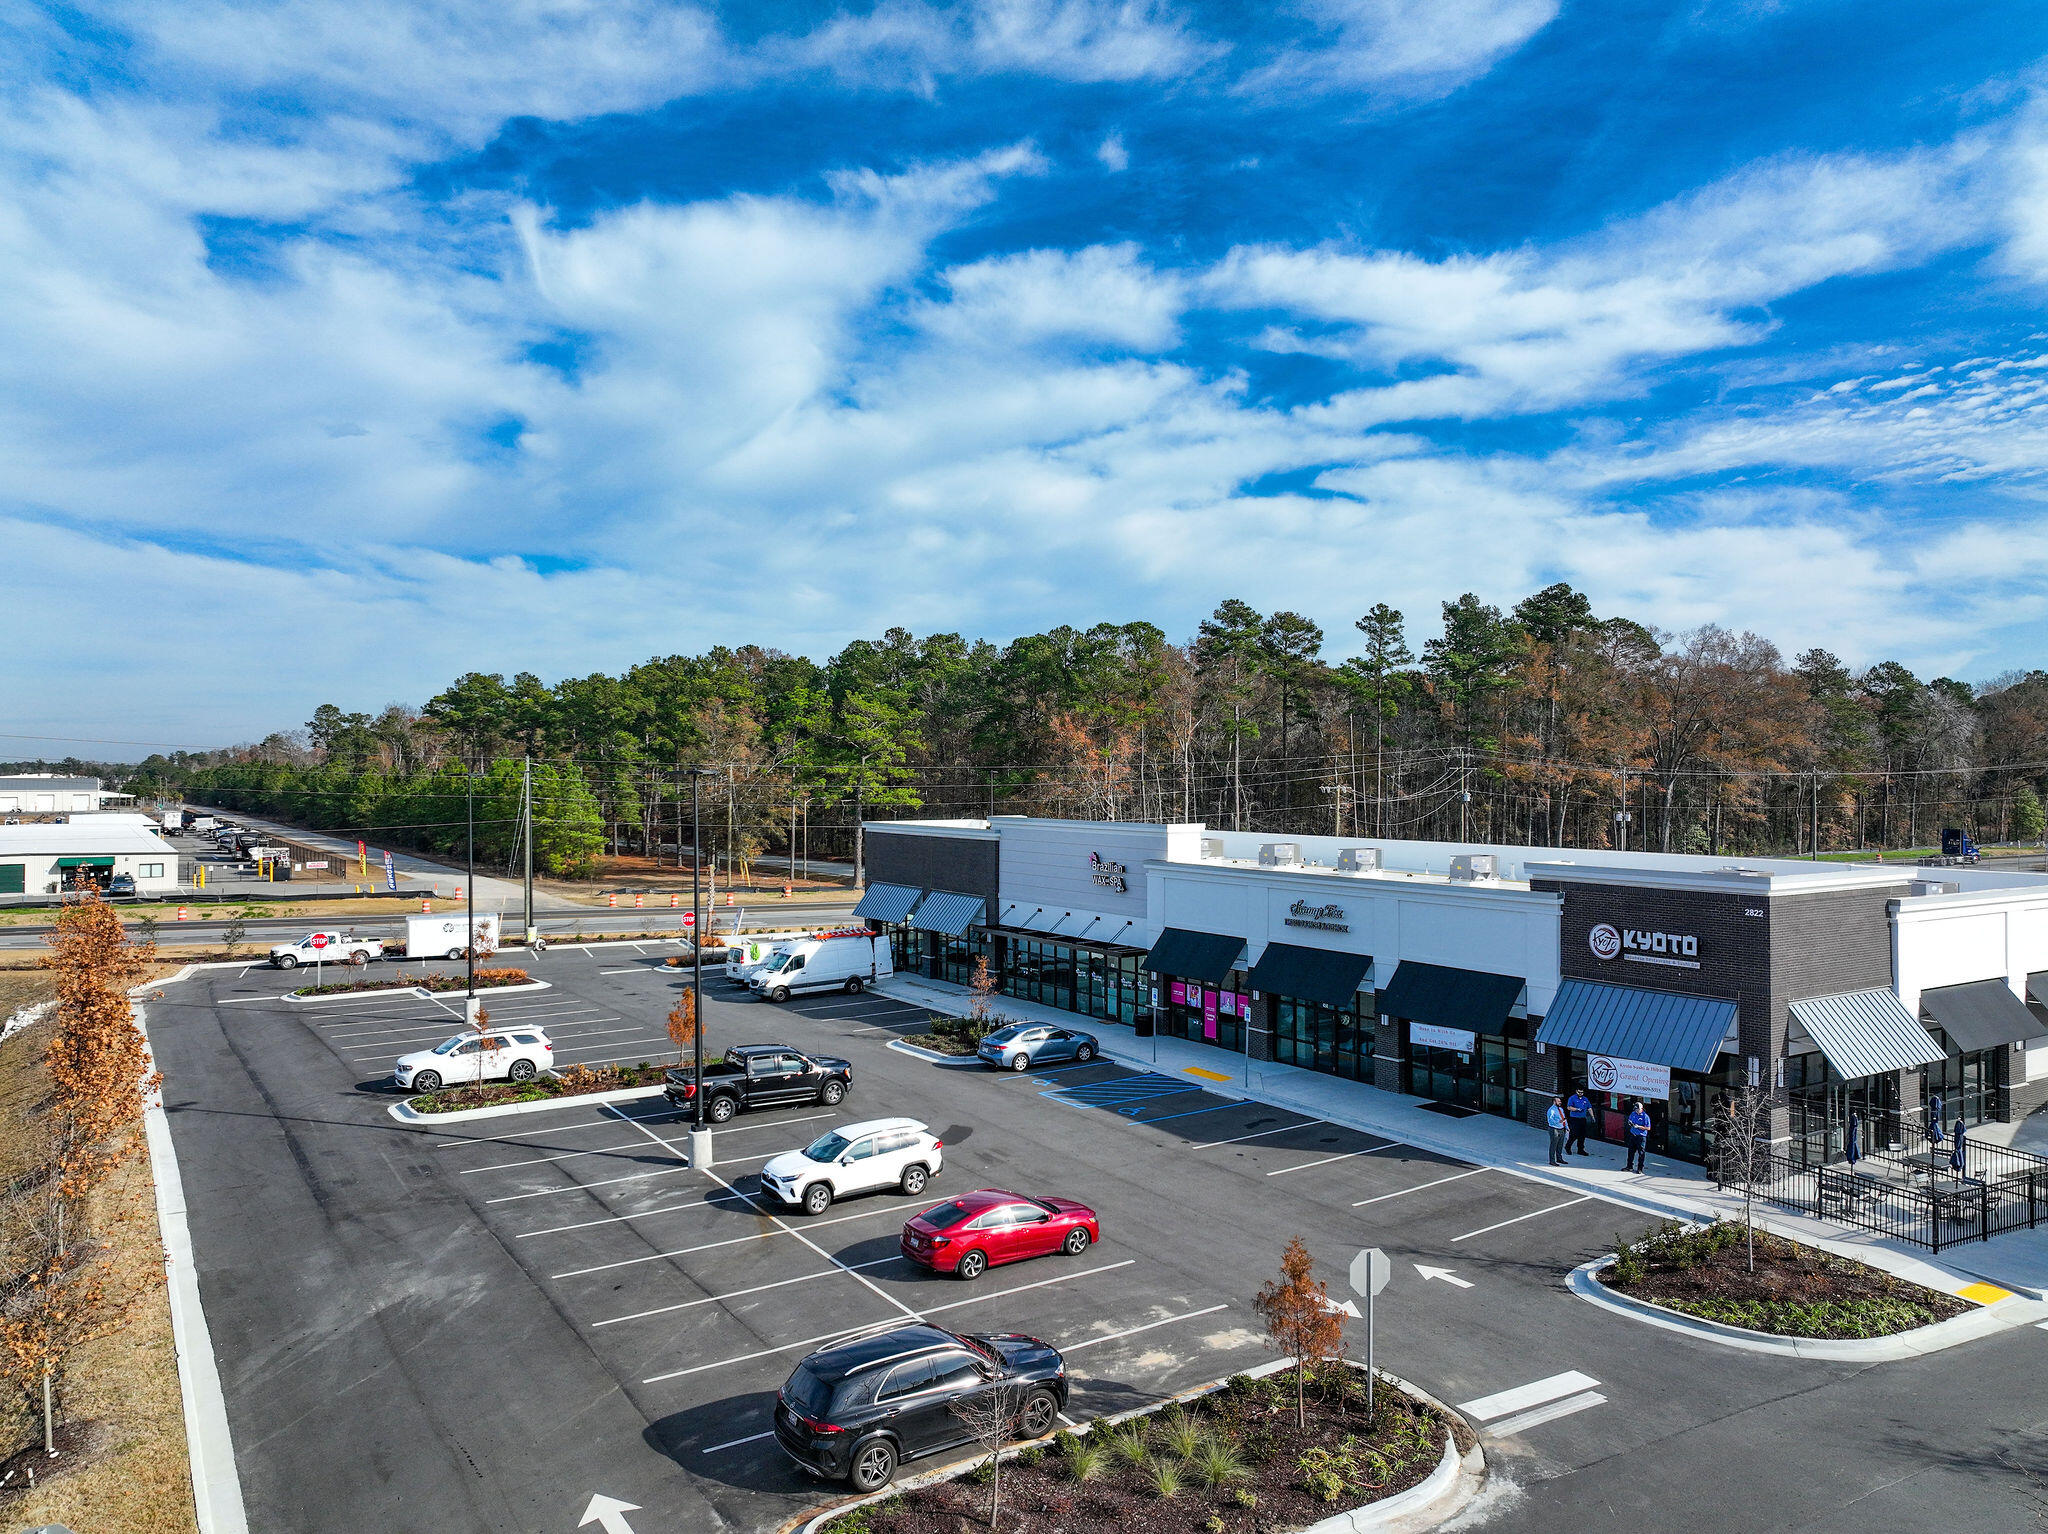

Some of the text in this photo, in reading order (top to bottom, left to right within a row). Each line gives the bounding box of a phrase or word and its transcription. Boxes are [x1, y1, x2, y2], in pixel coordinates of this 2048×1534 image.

[1091, 860, 1125, 873] Brazilian
[1744, 908, 1764, 918] 2822
[312, 937, 328, 945] STOP
[1623, 929, 1698, 957] KYOTO
[1619, 1072, 1670, 1088] Grand Opening
